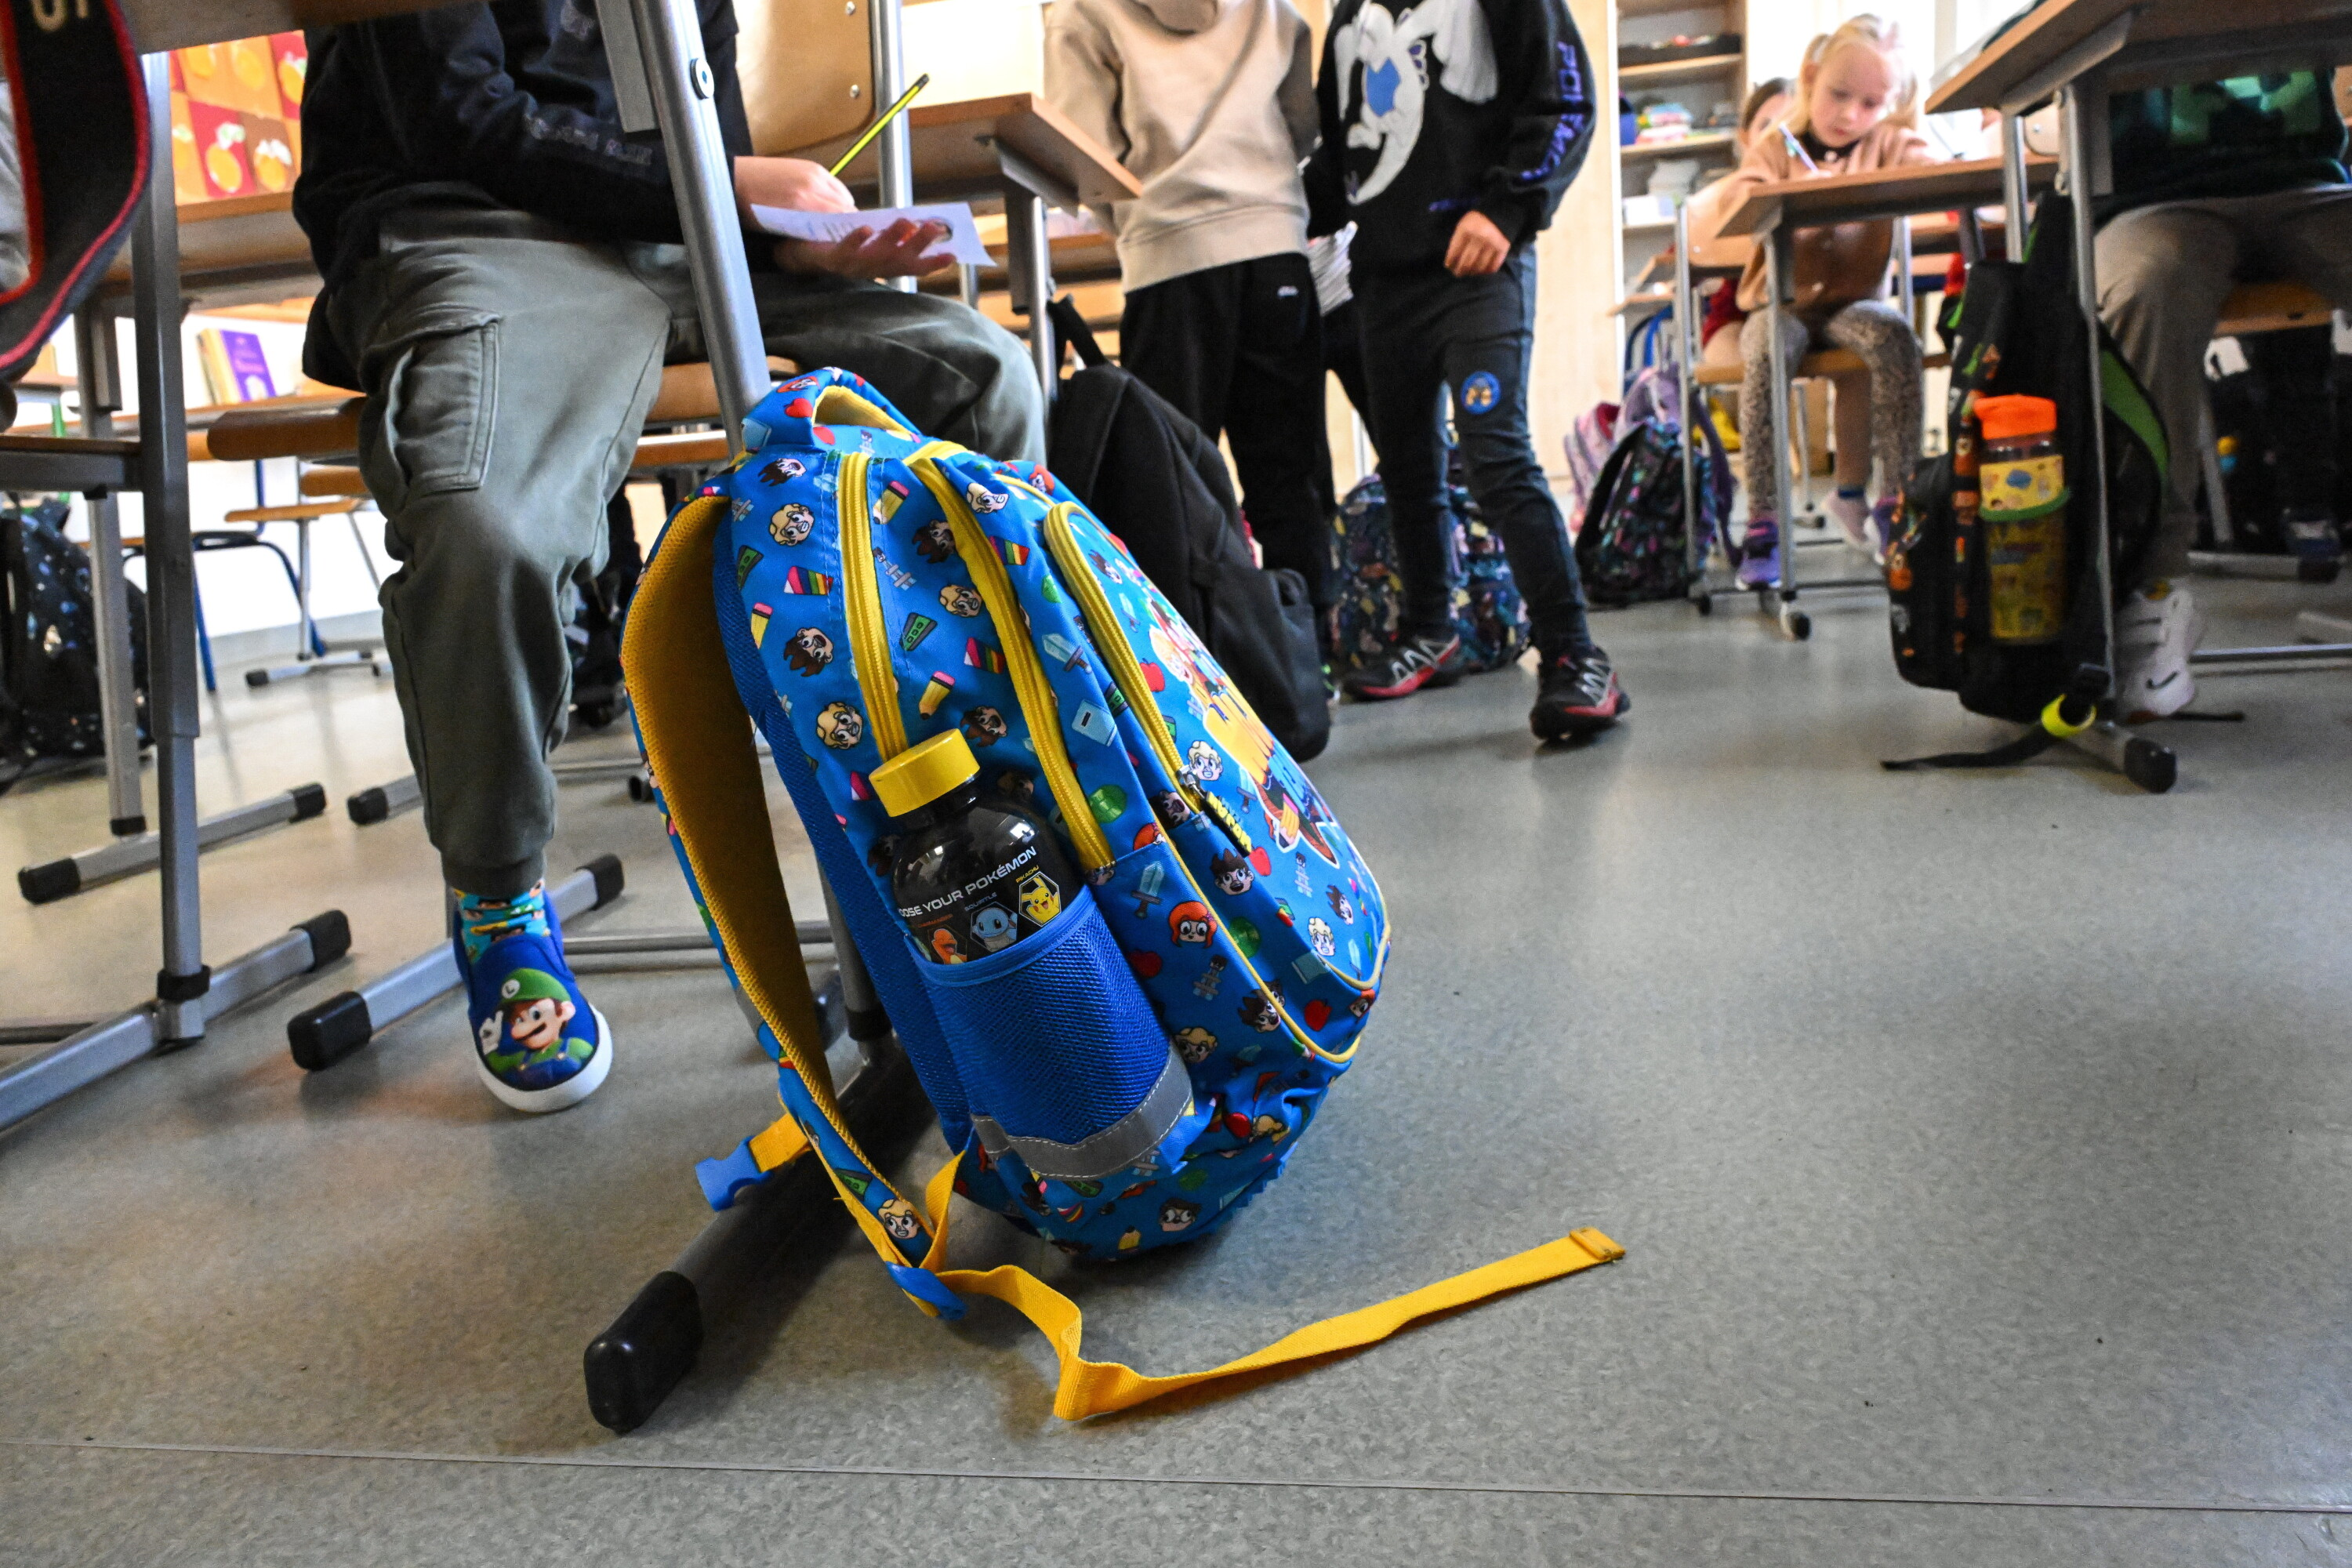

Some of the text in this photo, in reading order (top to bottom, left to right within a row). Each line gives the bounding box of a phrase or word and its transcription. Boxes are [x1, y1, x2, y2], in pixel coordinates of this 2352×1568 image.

[922, 890, 964, 912] YOUR
[964, 846, 1036, 895] POKÉMON
[1015, 865, 1040, 884] PIKACHU
[505, 984, 516, 995] L
